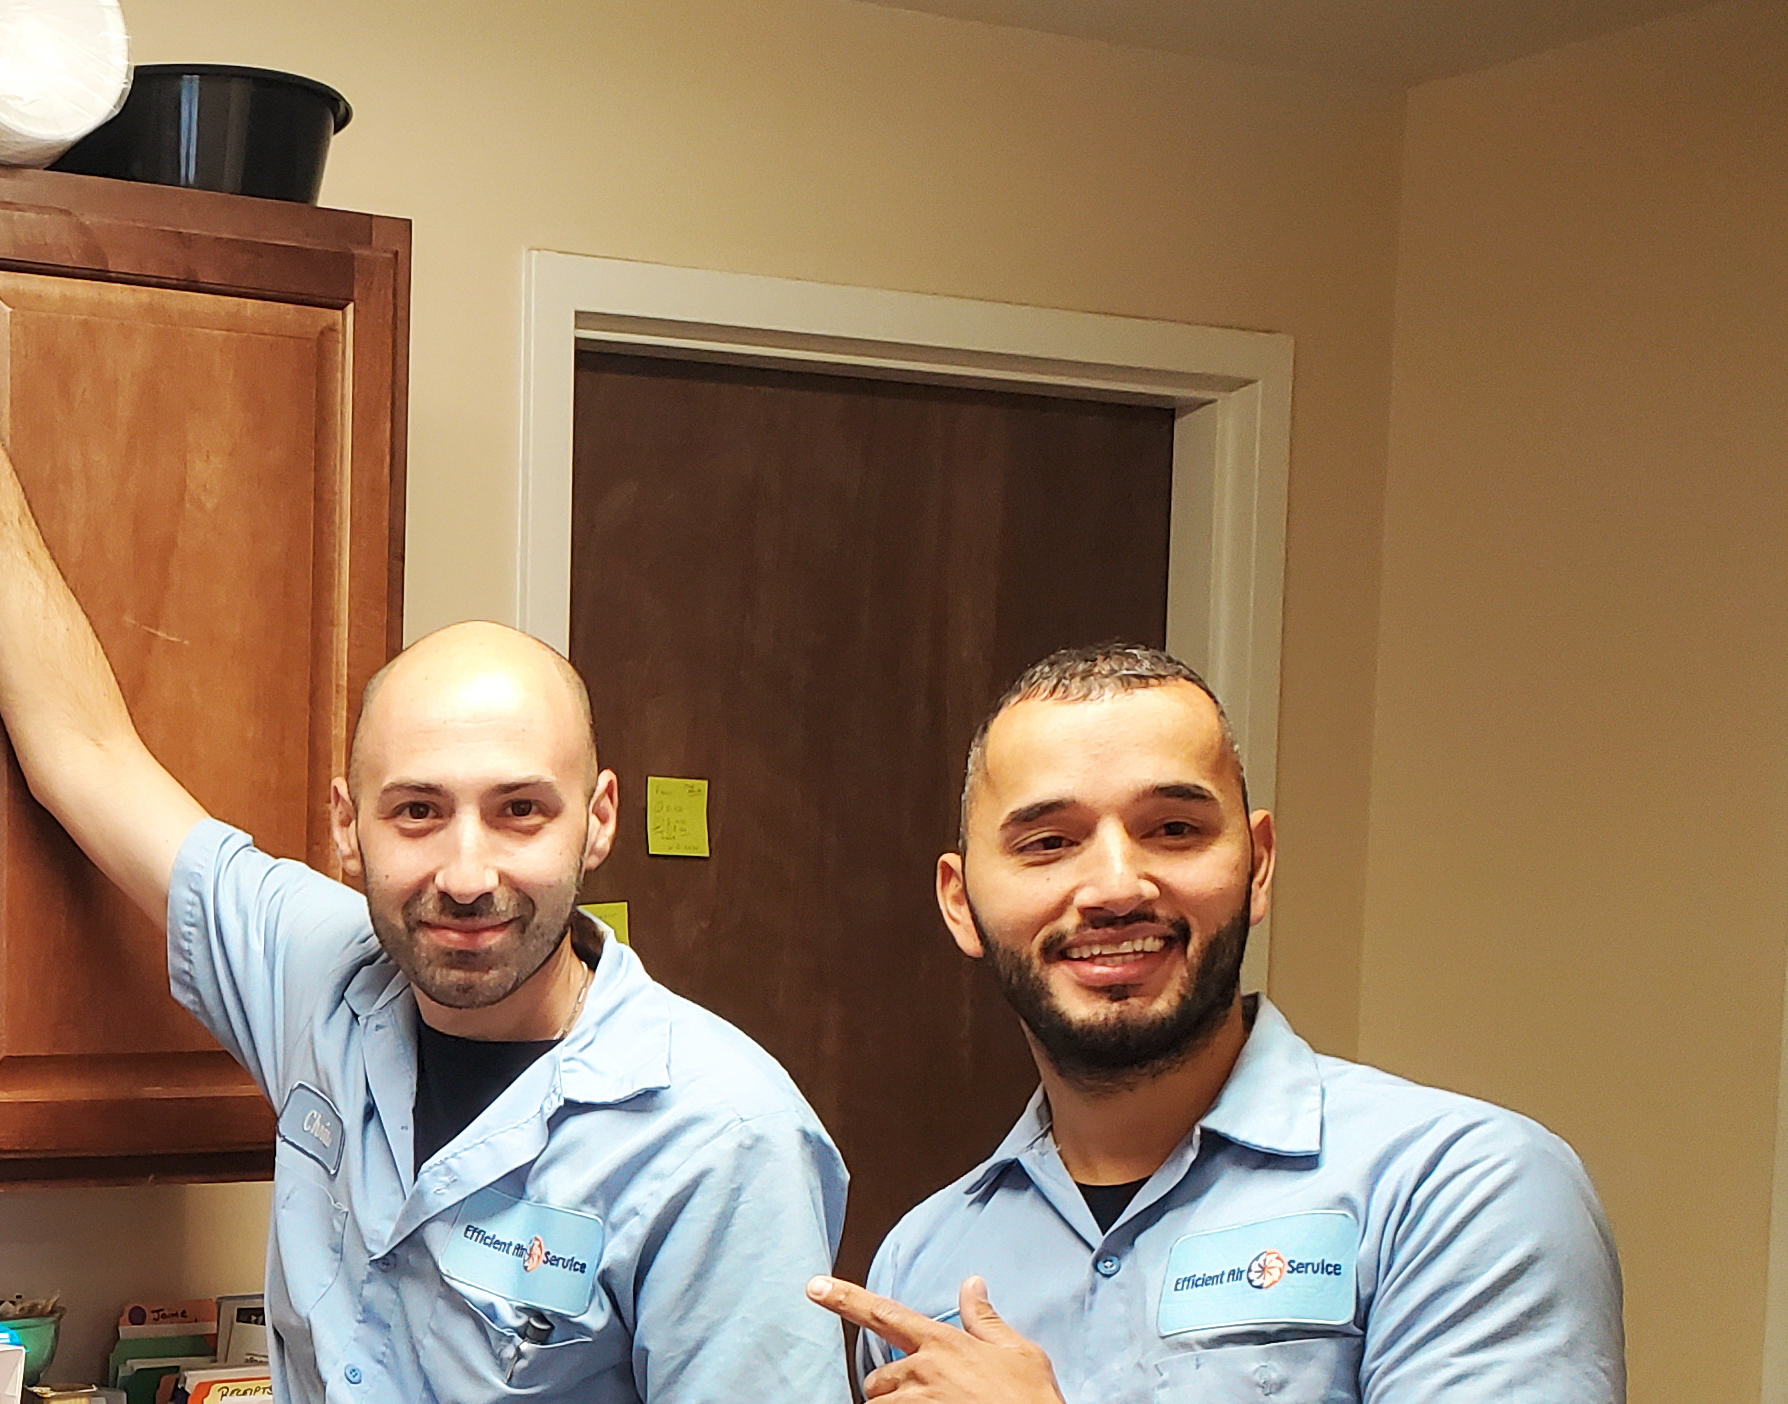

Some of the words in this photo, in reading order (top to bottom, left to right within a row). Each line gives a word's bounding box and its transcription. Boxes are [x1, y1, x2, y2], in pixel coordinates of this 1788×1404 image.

[463, 1224, 514, 1256] Efficient
[542, 1250, 587, 1274] Service
[1173, 1272, 1226, 1292] Efficient
[1226, 1266, 1246, 1283] Air
[1287, 1258, 1342, 1276] Service
